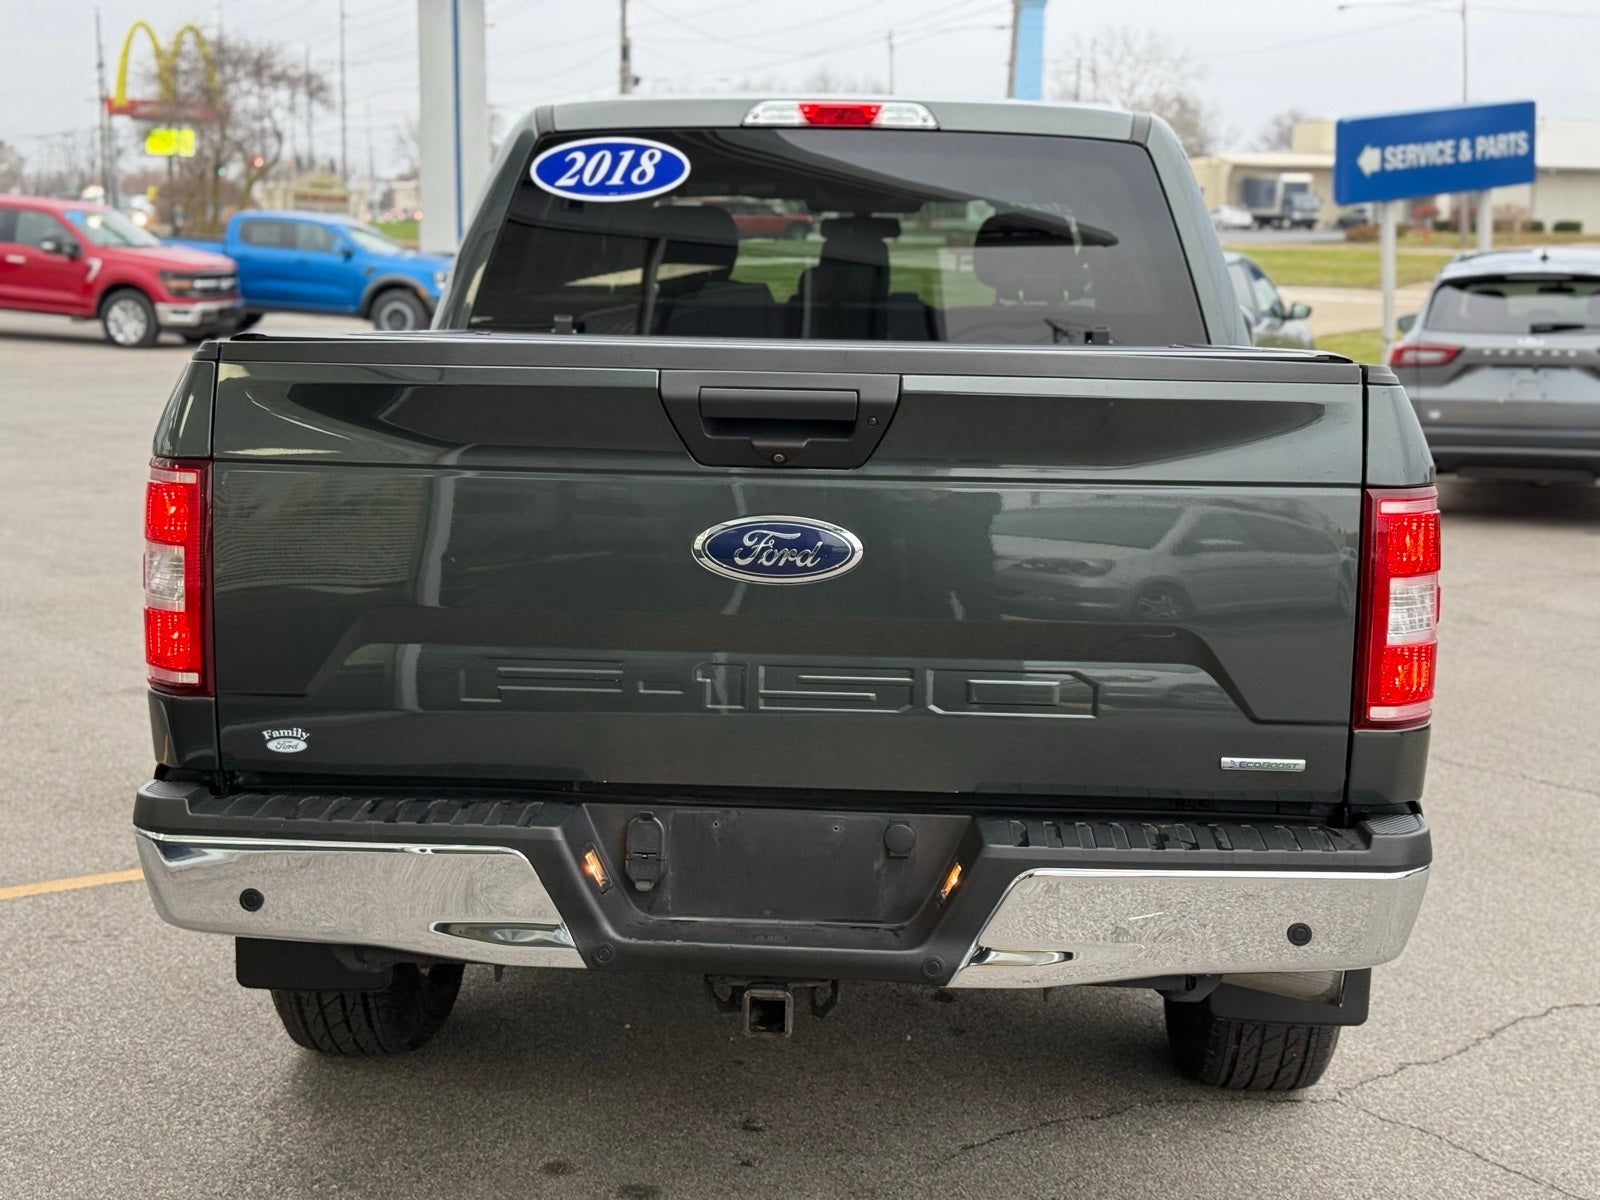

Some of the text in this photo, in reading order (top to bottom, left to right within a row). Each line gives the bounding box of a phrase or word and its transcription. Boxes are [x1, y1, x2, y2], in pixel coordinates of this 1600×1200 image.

[553, 148, 662, 187] 2018
[1383, 130, 1530, 171] SERVICE & PARTS
[733, 529, 824, 567] Ford
[458, 655, 1097, 719] F-150
[261, 727, 310, 741] Family
[275, 740, 299, 750] Ford
[1239, 760, 1300, 769] ECOBOOST
